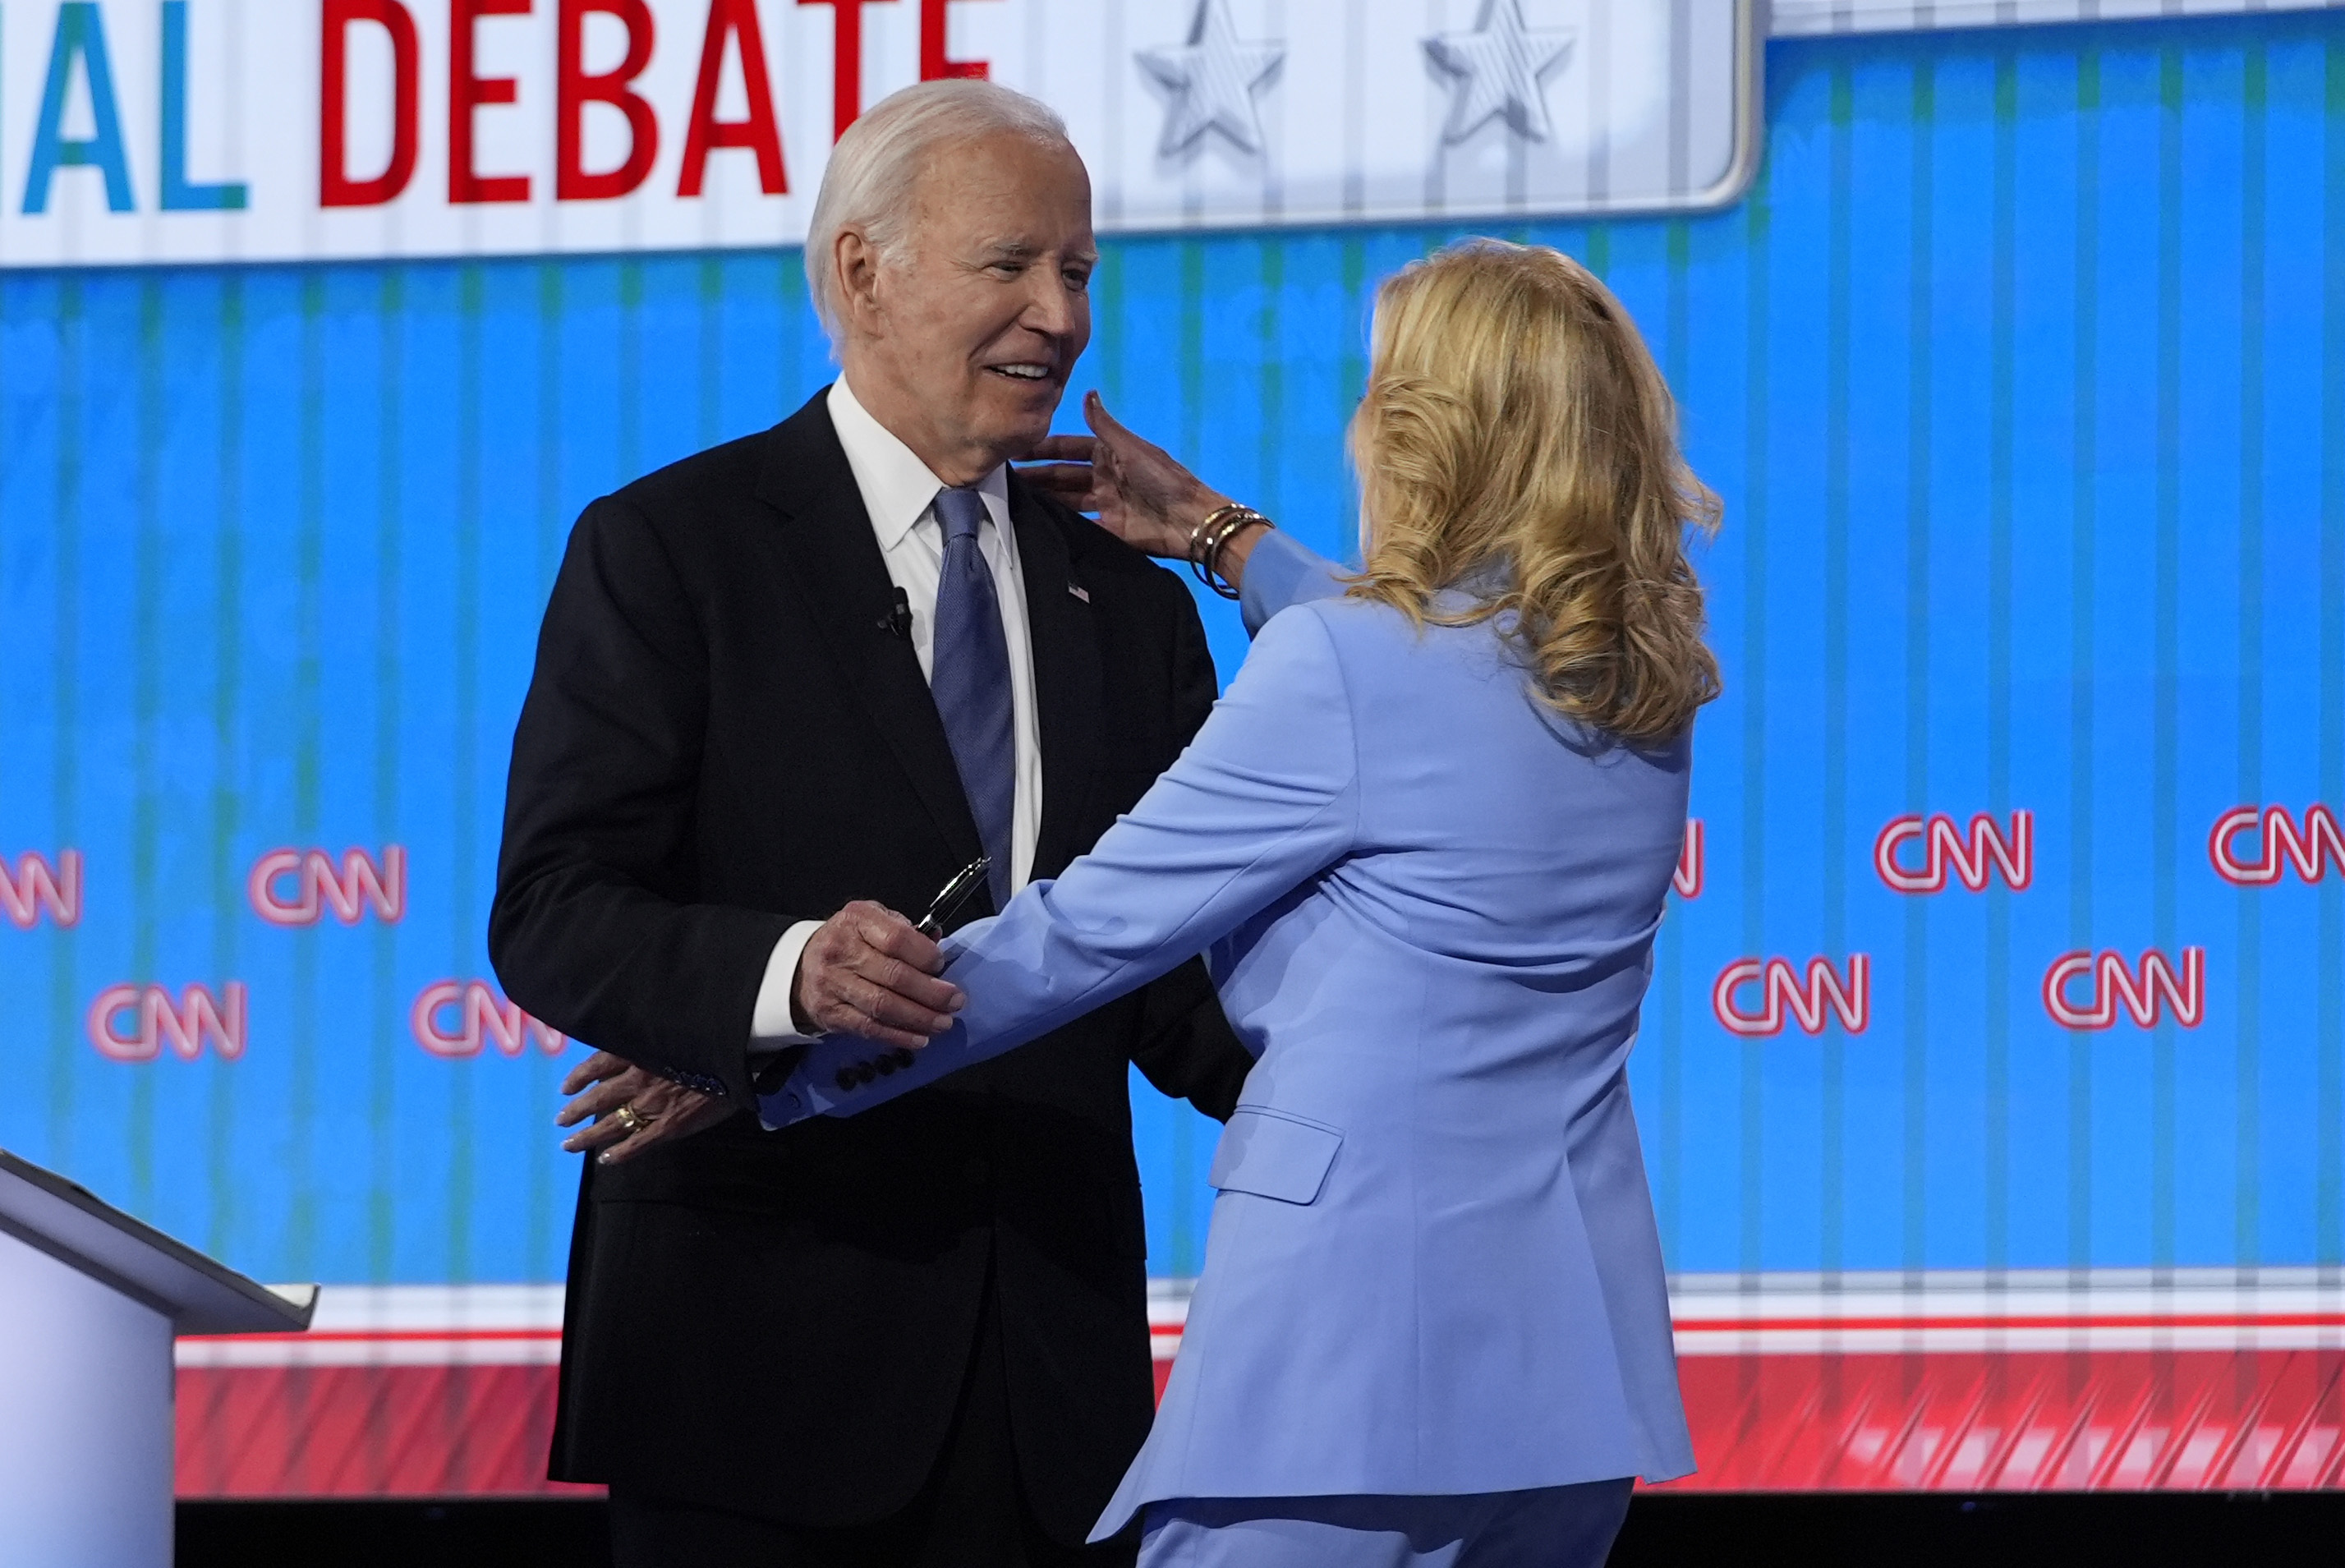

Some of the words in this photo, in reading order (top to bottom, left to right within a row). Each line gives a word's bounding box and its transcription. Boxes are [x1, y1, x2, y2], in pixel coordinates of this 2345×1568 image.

[0, 0, 251, 214] AL
[0, 848, 84, 930] NN
[249, 844, 406, 926] CNN
[1874, 808, 2033, 895] CNN
[88, 982, 246, 1061] CNN
[1713, 953, 1869, 1037] CNN
[2043, 946, 2205, 1031] CNN
